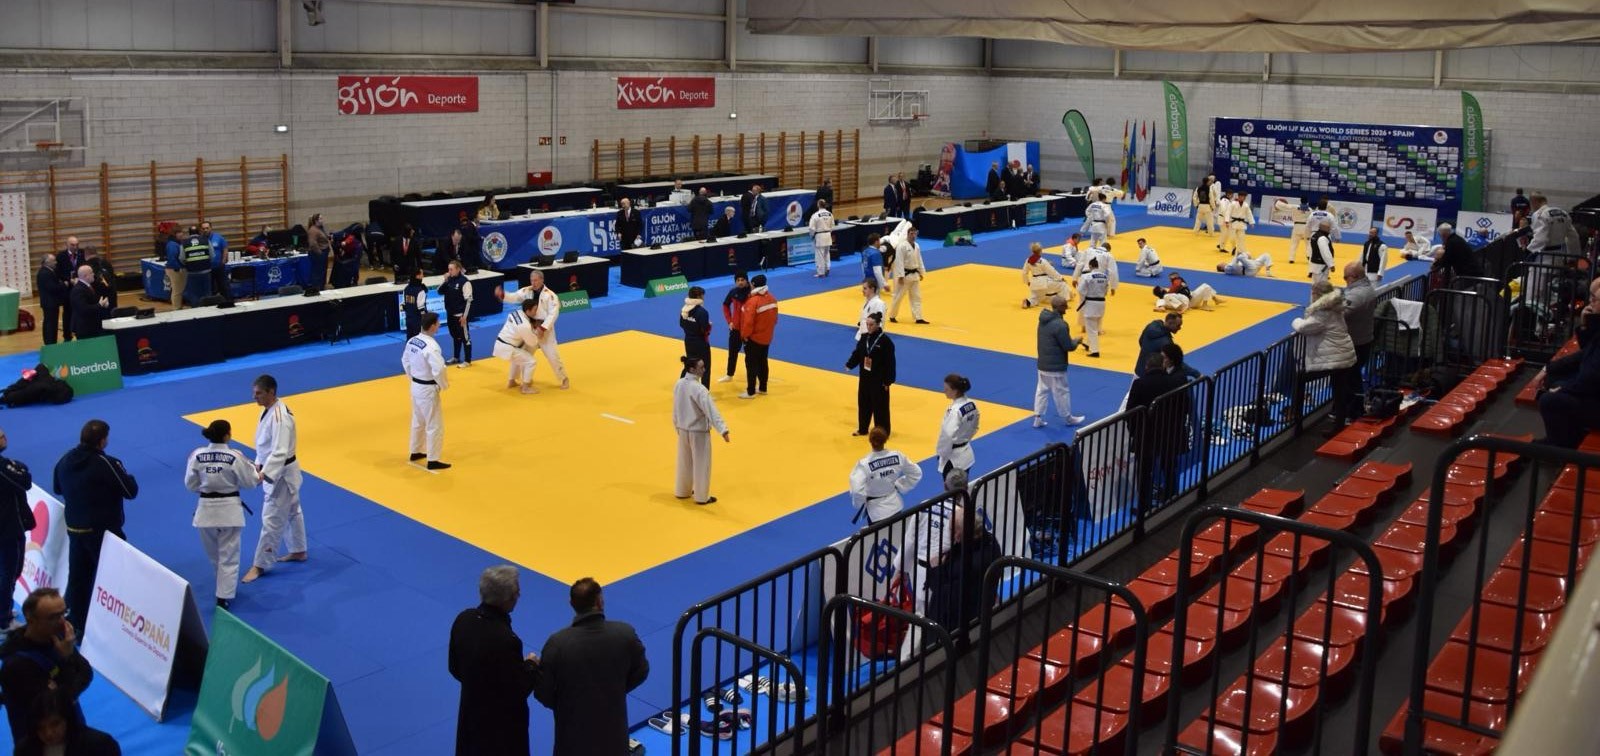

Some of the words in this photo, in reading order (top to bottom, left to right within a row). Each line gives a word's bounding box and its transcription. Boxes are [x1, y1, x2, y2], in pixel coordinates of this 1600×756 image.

[428, 93, 467, 107] Deporte
[679, 90, 709, 102] Deporte
[1345, 128, 1370, 136] SERIES
[1392, 130, 1415, 138] SPAIN
[1154, 200, 1183, 213] Daedo
[651, 212, 676, 225] GIJÓN
[662, 223, 680, 233] KATA
[651, 234, 671, 244] 2026
[70, 359, 118, 376] Iberdrola
[206, 466, 223, 474] ESP
